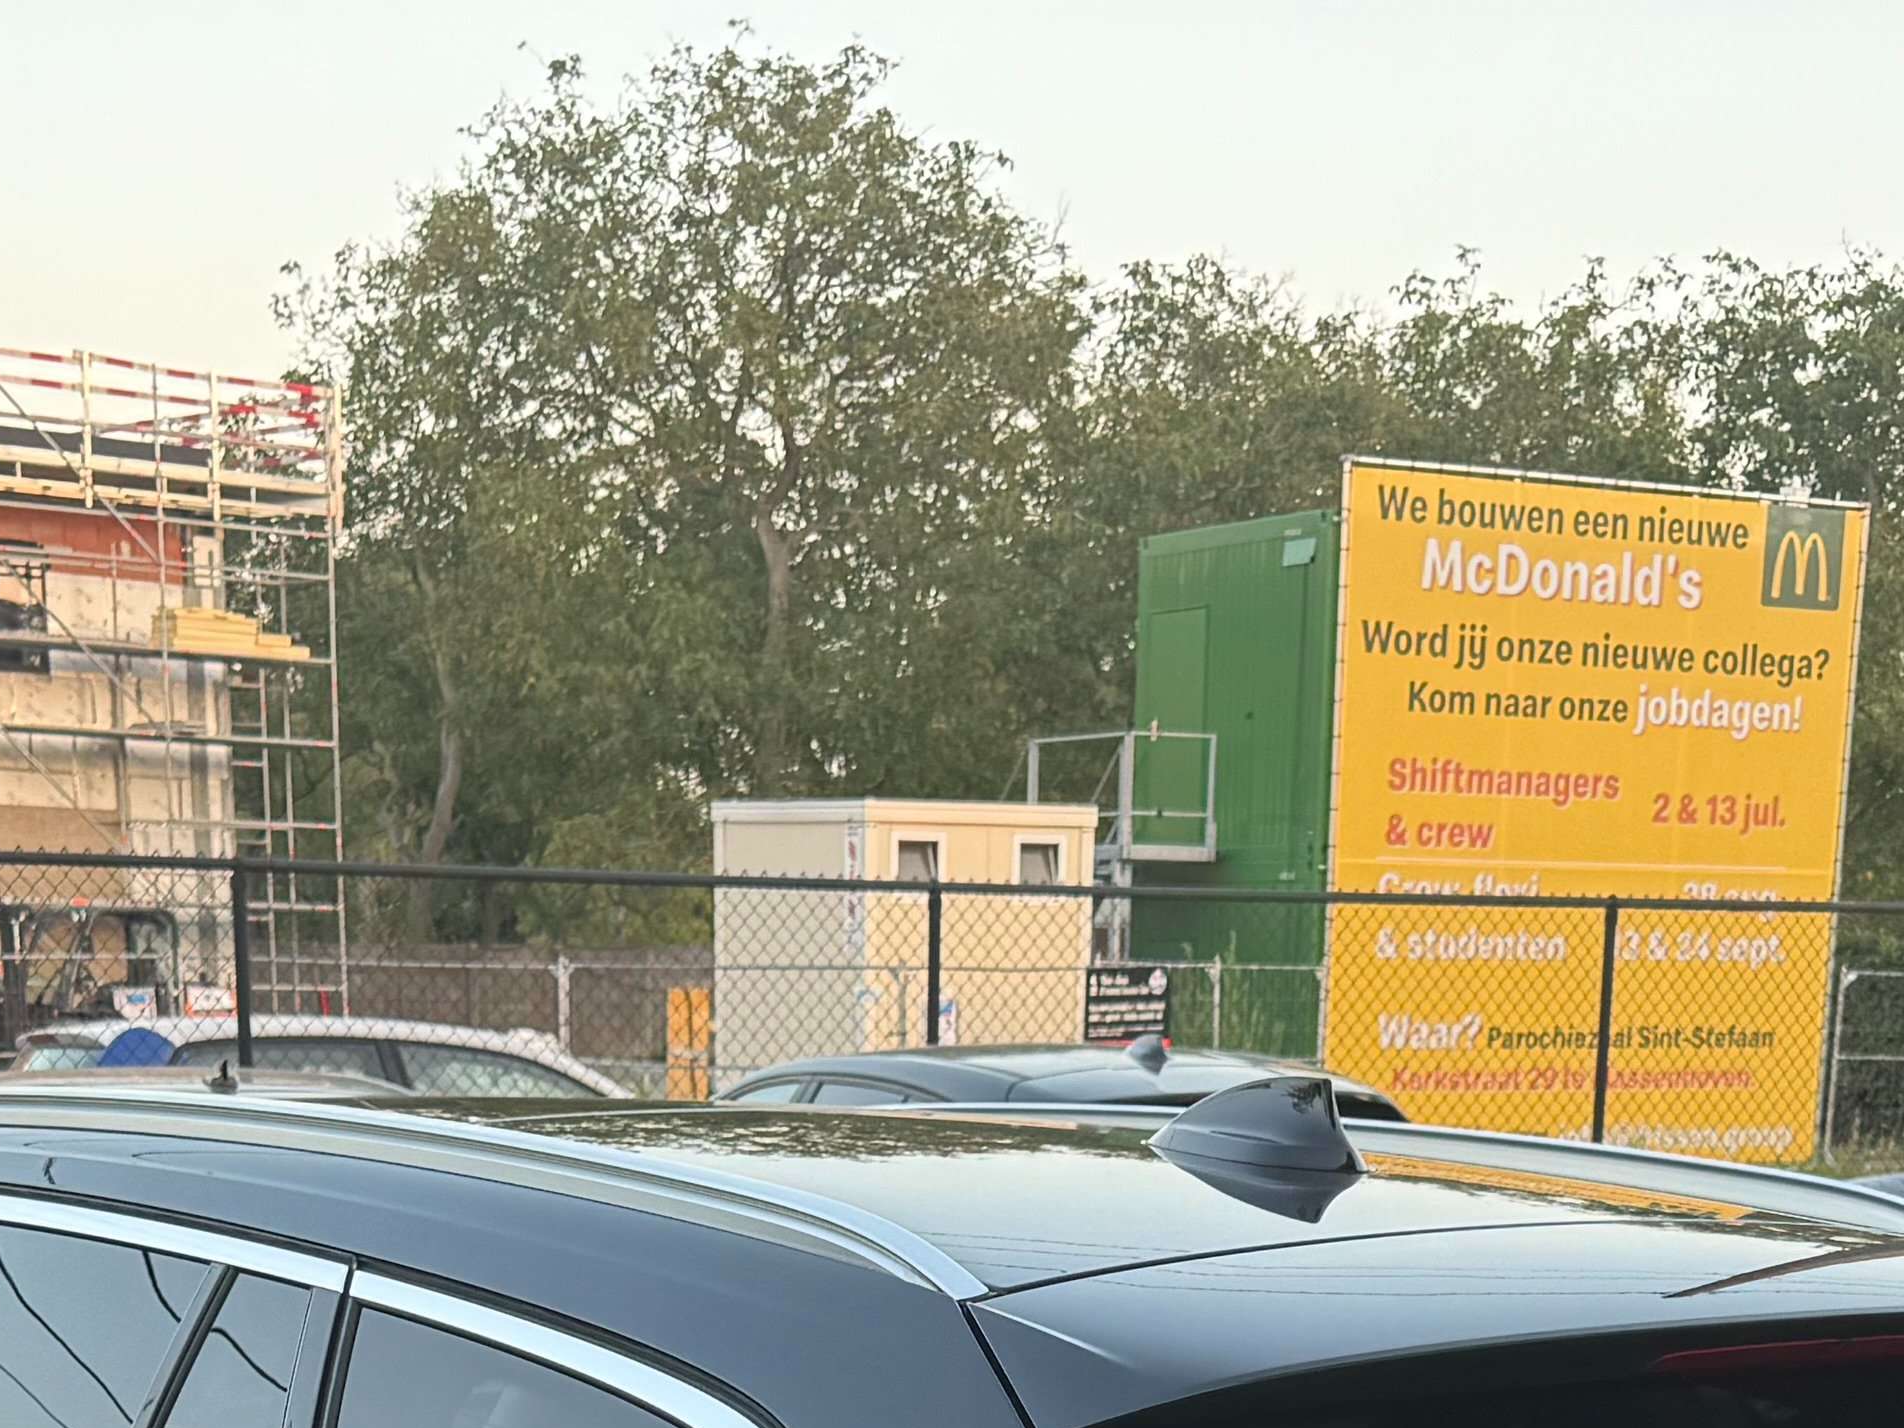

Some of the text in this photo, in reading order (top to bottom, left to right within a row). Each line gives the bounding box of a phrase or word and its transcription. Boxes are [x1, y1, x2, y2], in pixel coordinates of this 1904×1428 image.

[1378, 485, 1749, 550] We bouwen een nieuwe
[1420, 537, 1703, 610] McDonald's
[1361, 619, 1830, 688] Word jij onze nieuwe collega?
[1408, 681, 1802, 740] Kom naar onze jobdagen!
[1387, 757, 1620, 806] Shiftmanagers
[1386, 814, 1494, 849] & crew
[1652, 793, 1786, 835] 2 & 13 jul.
[1408, 927, 1567, 960] studenten
[1378, 1012, 1483, 1050] Waar?
[1488, 1025, 1632, 1050] Parochiezal
